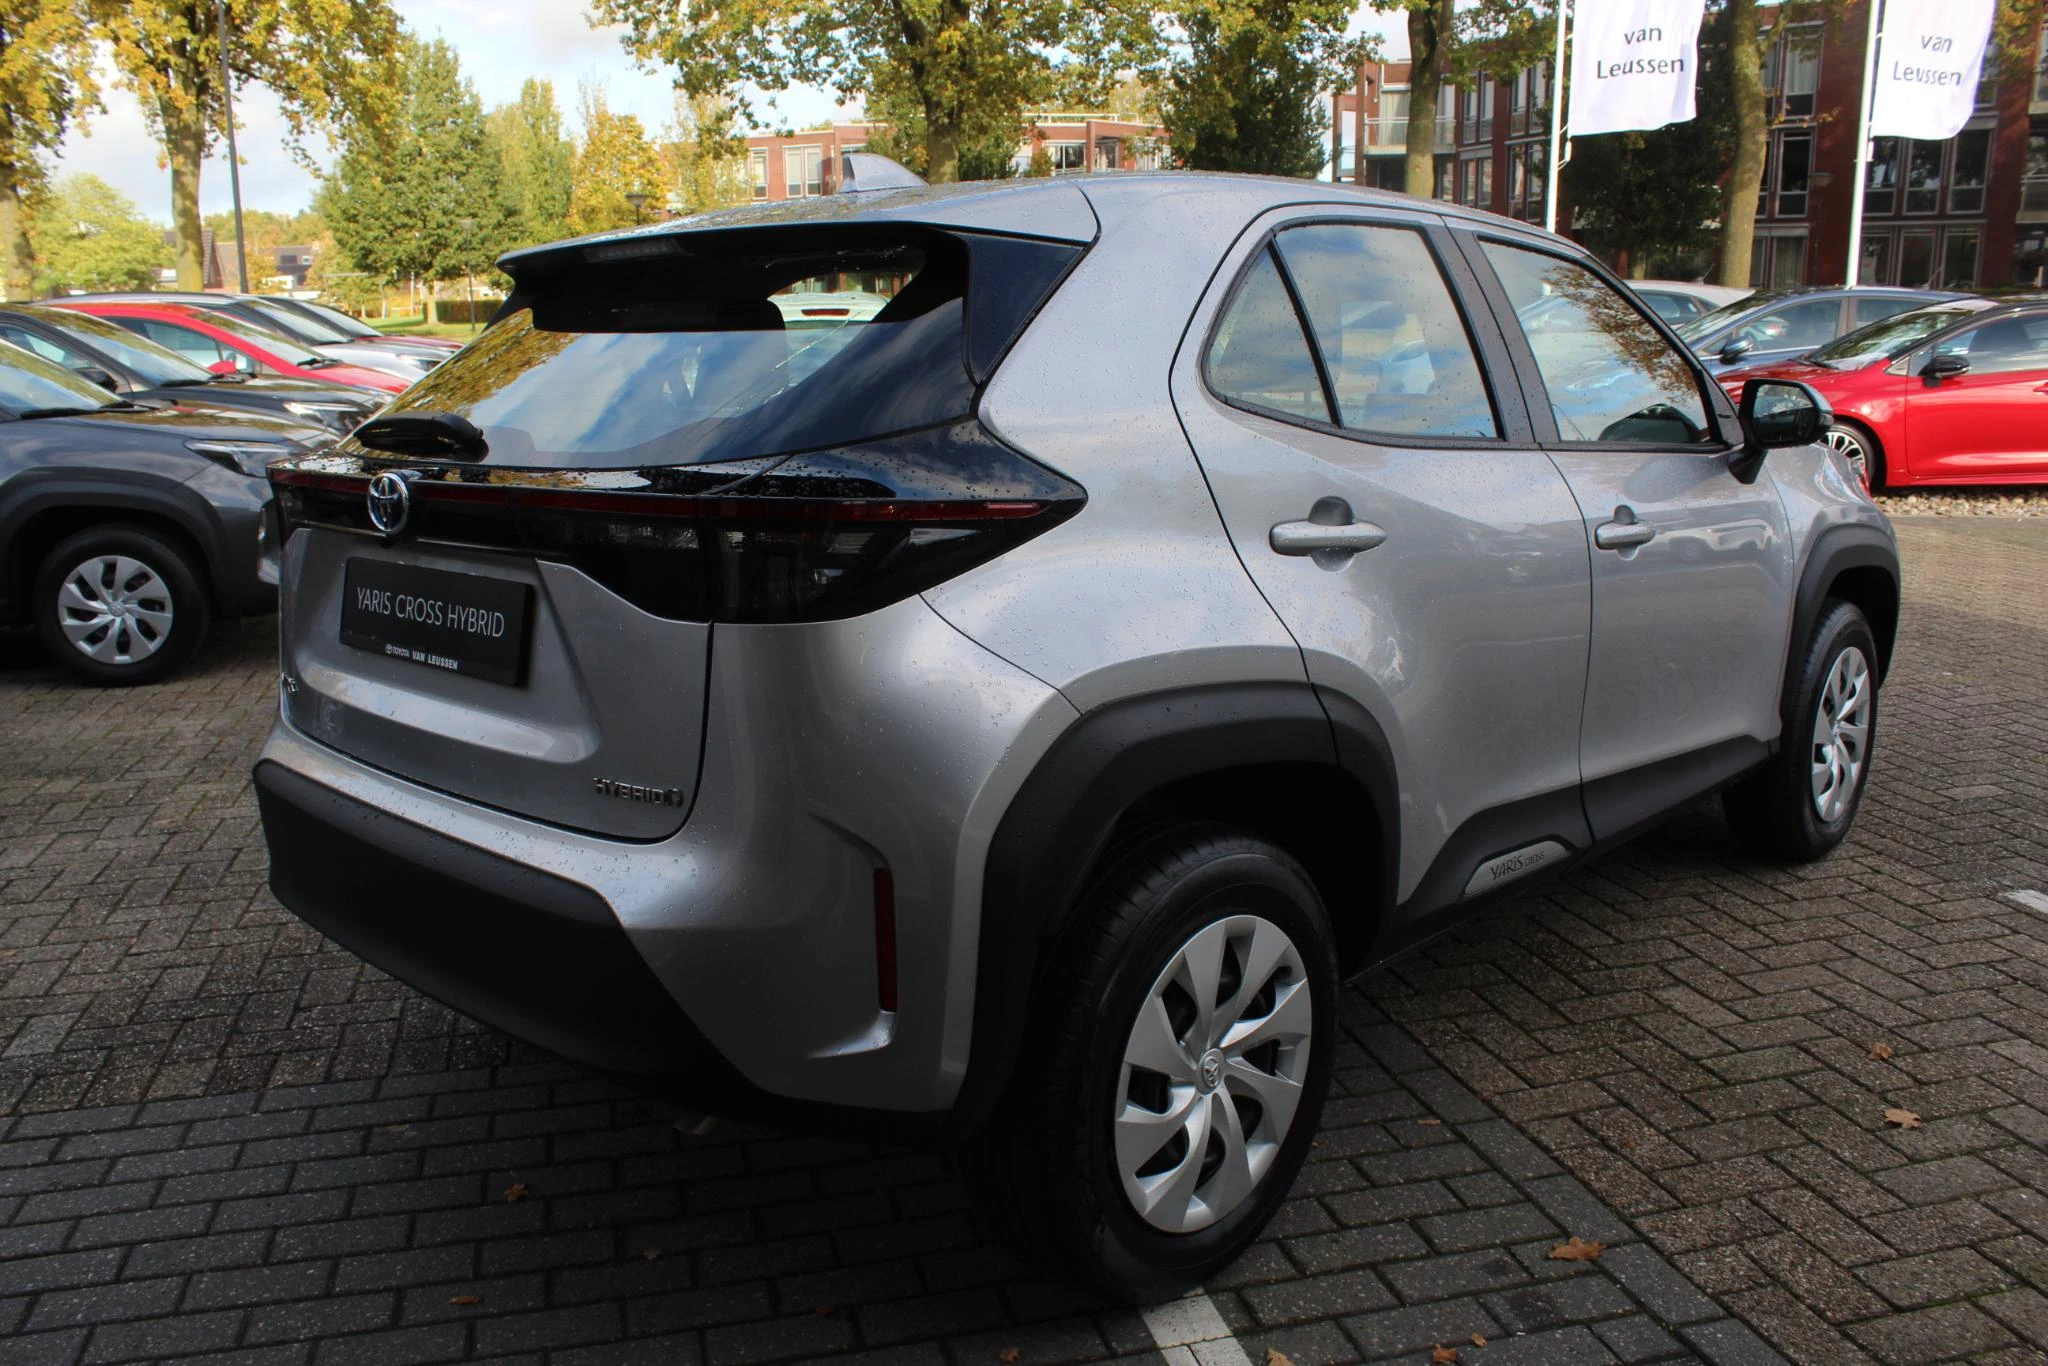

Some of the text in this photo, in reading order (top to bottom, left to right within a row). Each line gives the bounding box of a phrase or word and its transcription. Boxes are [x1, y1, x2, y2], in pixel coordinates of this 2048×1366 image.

[1623, 26, 1662, 45] van
[1920, 35, 1954, 53] van
[1596, 58, 1685, 79] Leussen
[1893, 61, 1963, 86] Leussen
[356, 586, 505, 637] YARIS CROSS HYBRID
[393, 646, 459, 670] TOYOTA VAN LEUSSEN
[592, 777, 665, 807] HYBRID
